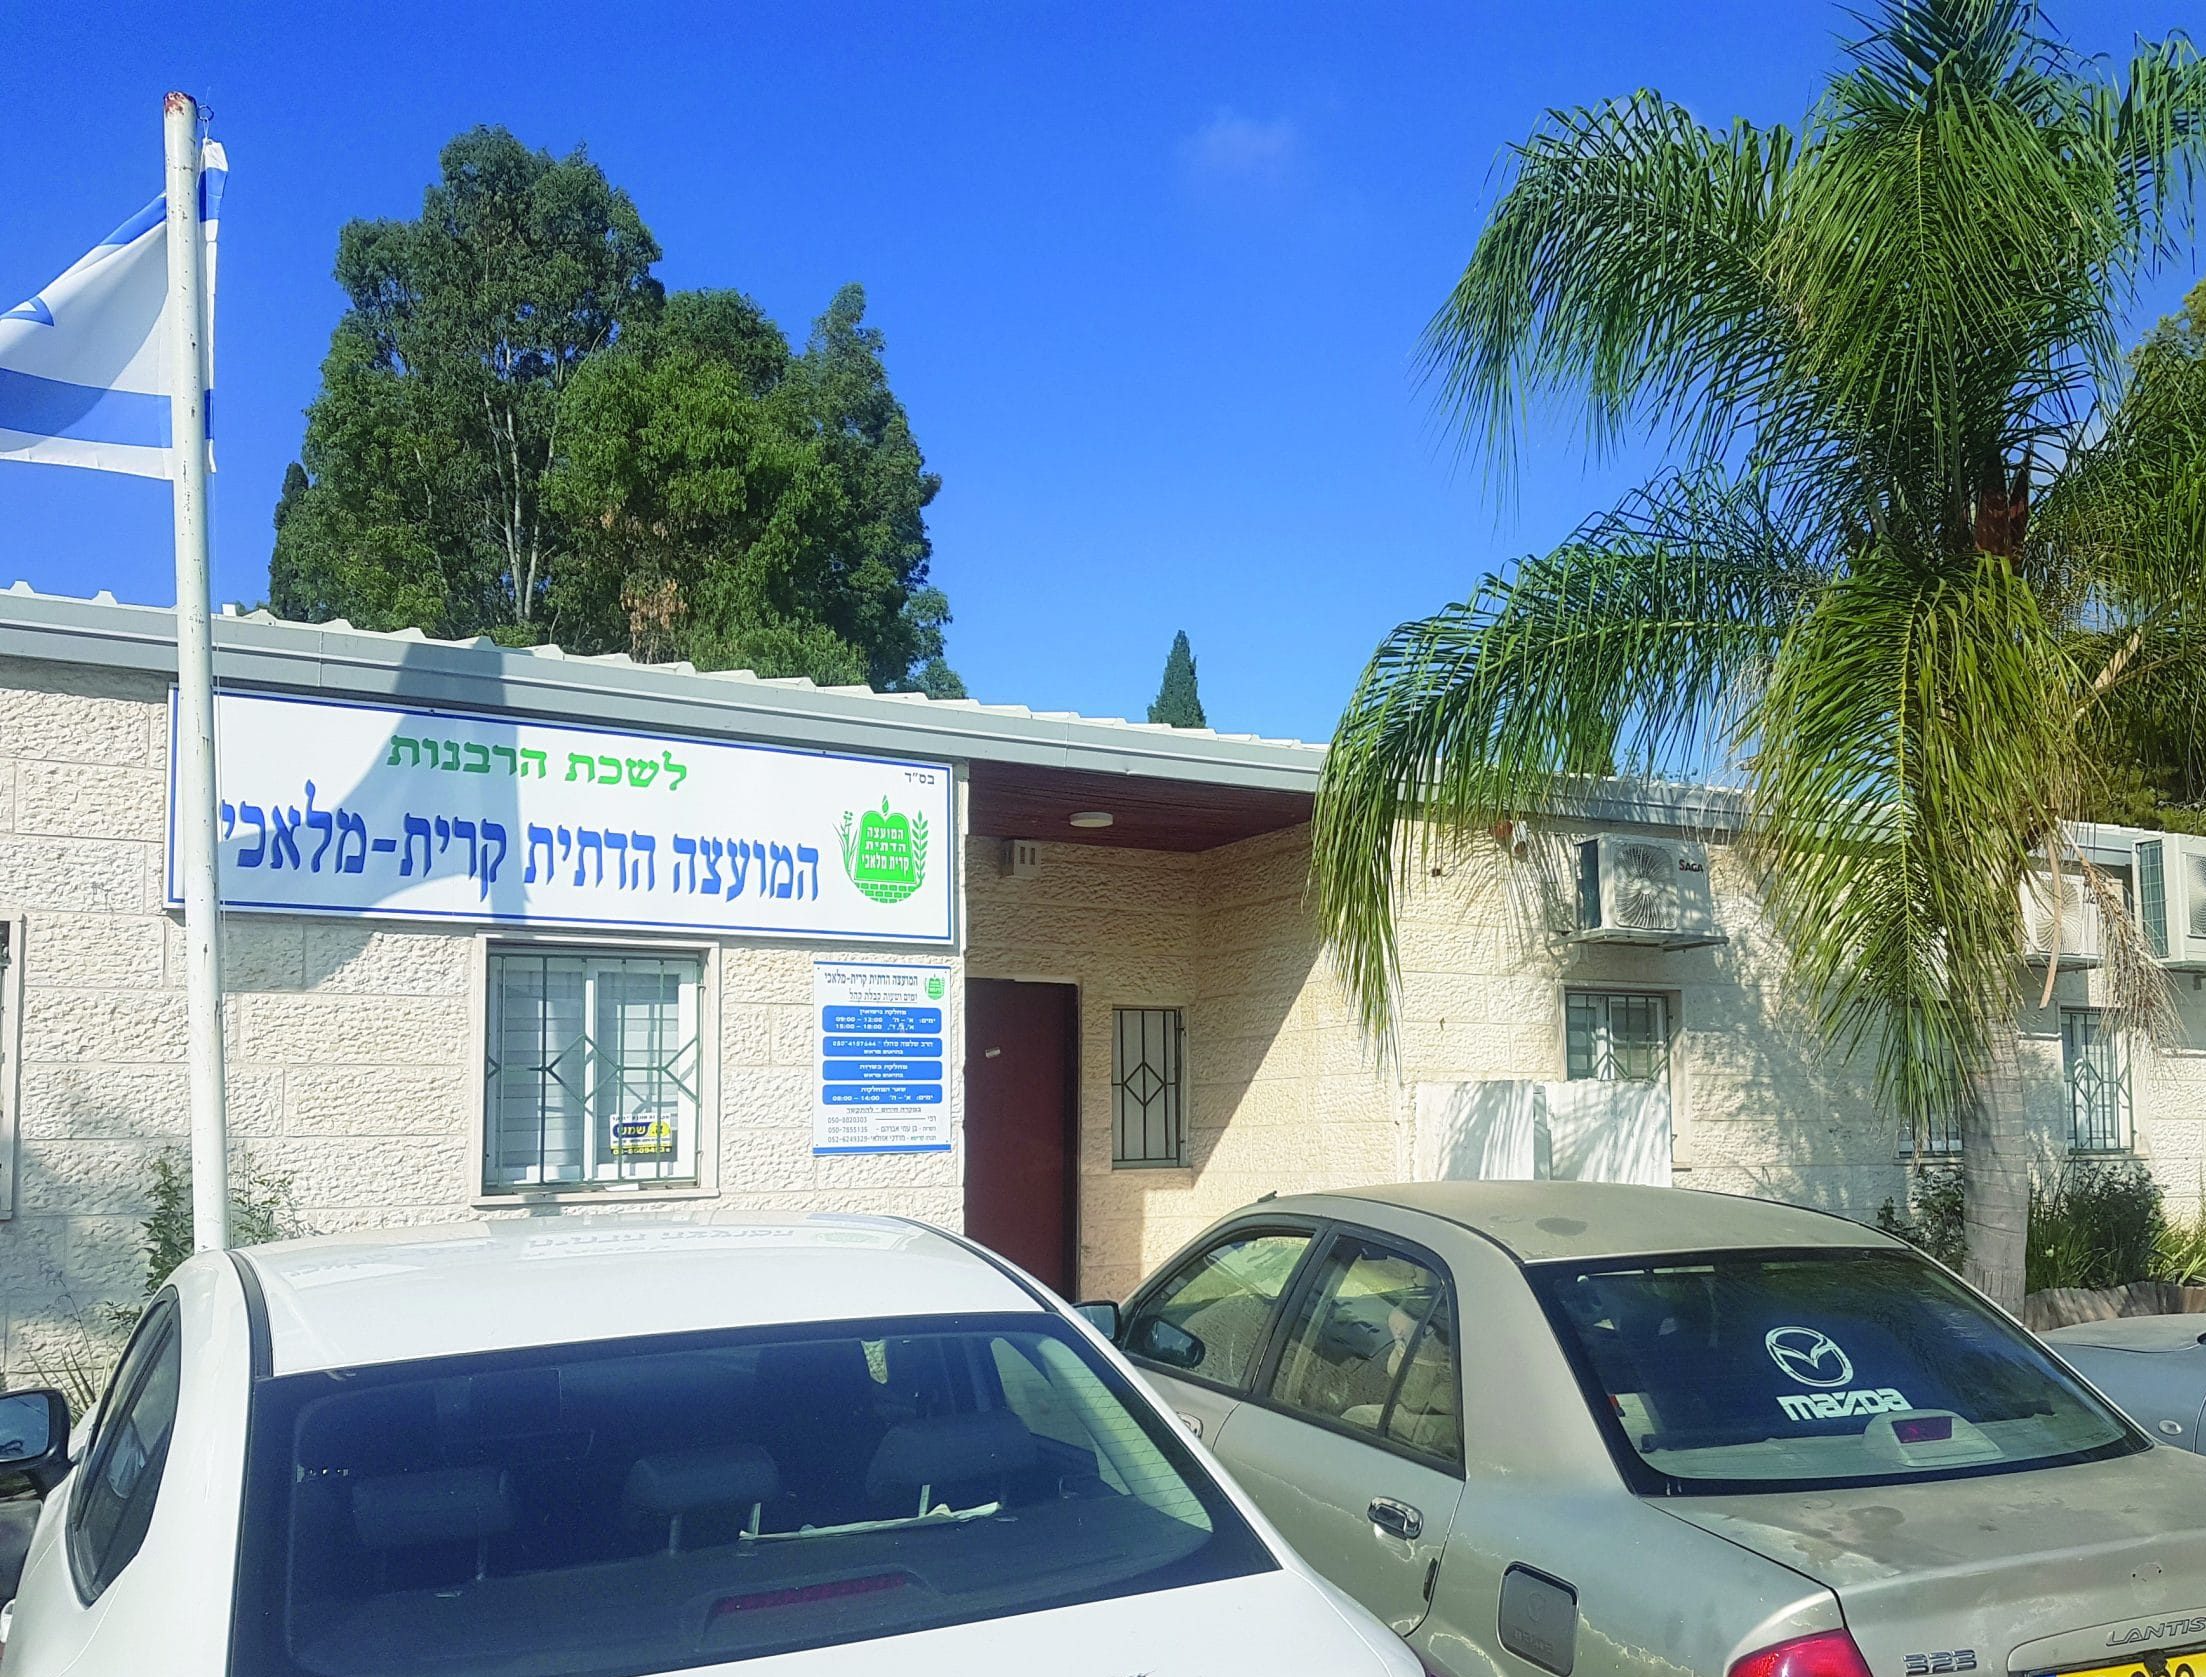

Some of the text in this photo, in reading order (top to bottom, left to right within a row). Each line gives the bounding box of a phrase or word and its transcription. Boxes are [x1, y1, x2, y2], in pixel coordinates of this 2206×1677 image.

[386, 735, 687, 791] לשכת הרבנות
[904, 772, 935, 785] בס"ד
[865, 826, 904, 841] המועצה
[865, 840, 907, 852] הדתית
[523, 822, 656, 892] הדתית
[672, 834, 819, 902] המועצה
[862, 852, 909, 877] קרית מלאכי
[869, 973, 890, 985] הדתית
[892, 974, 918, 986] המועצה
[2106, 1617, 2206, 1647] LANTIS
[1903, 1648, 1978, 1677] 323
